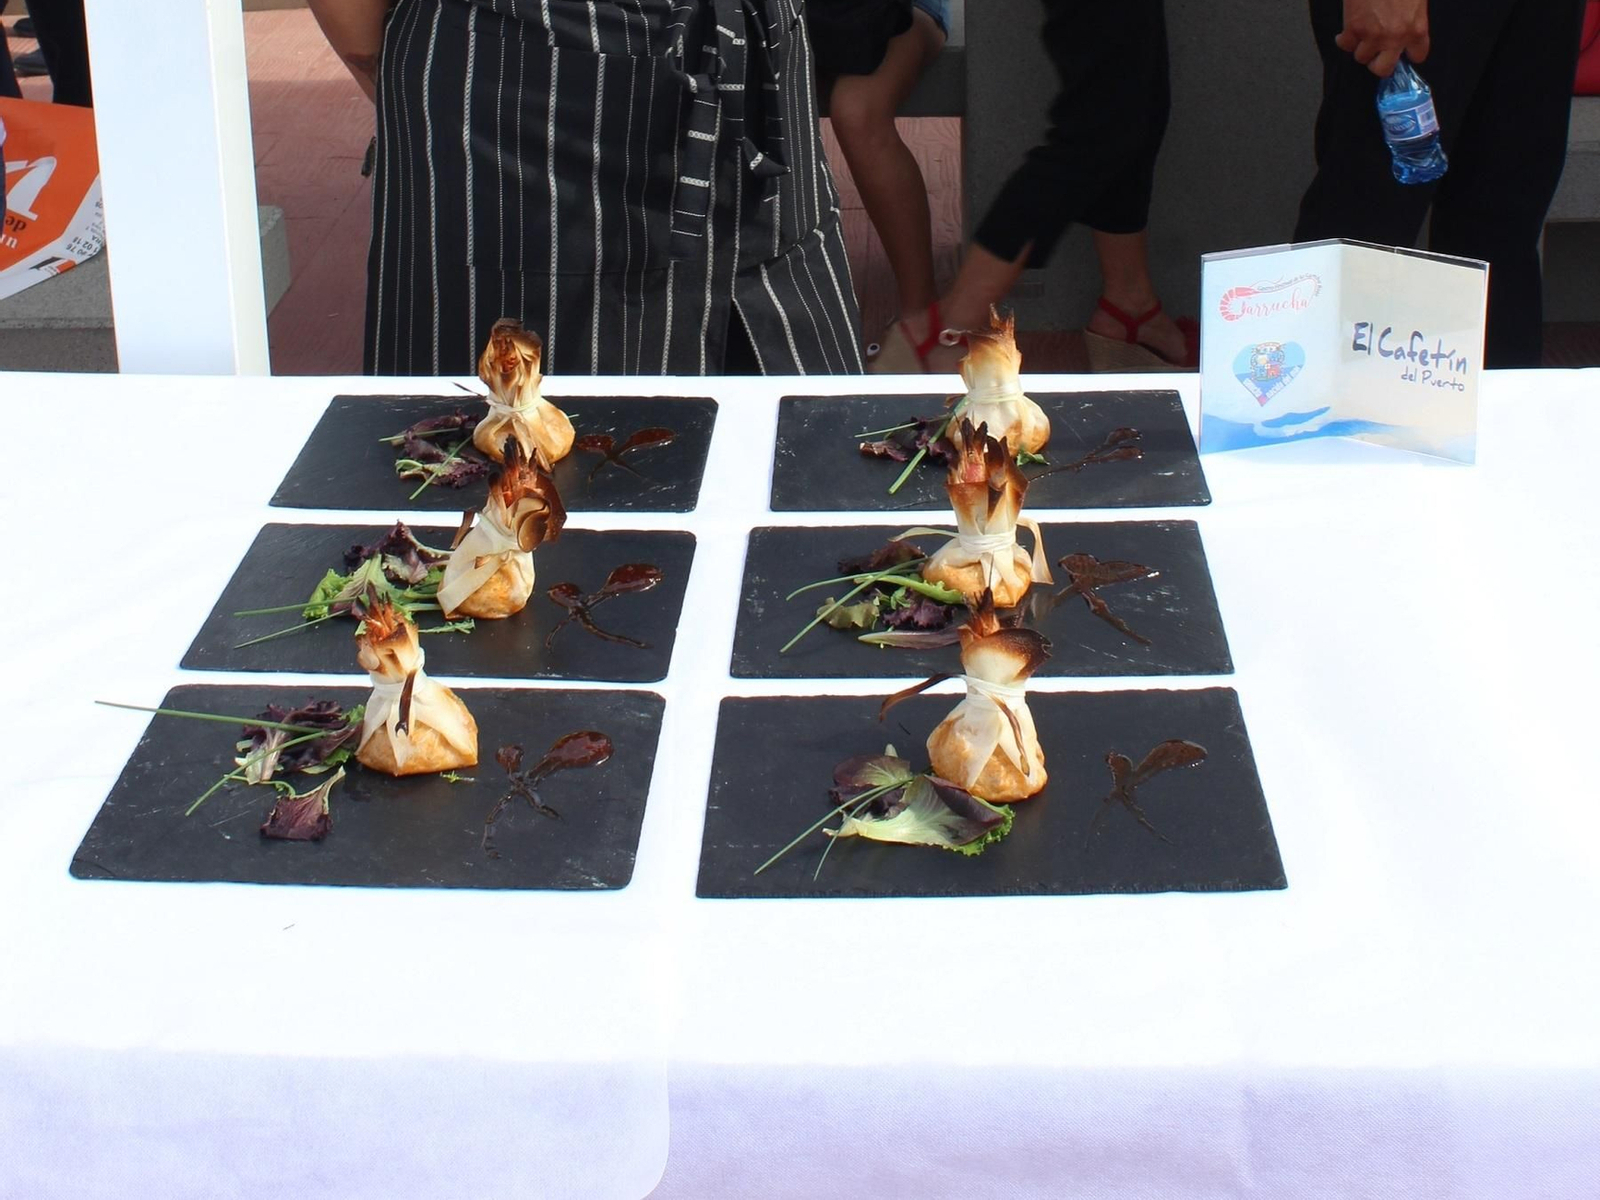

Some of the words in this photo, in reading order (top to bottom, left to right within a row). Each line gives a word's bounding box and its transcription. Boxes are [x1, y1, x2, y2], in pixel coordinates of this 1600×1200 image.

[1352, 321, 1373, 356] El
[1378, 327, 1467, 375] Cafetín
[1401, 366, 1418, 382] del
[1421, 369, 1465, 393] Puerto
